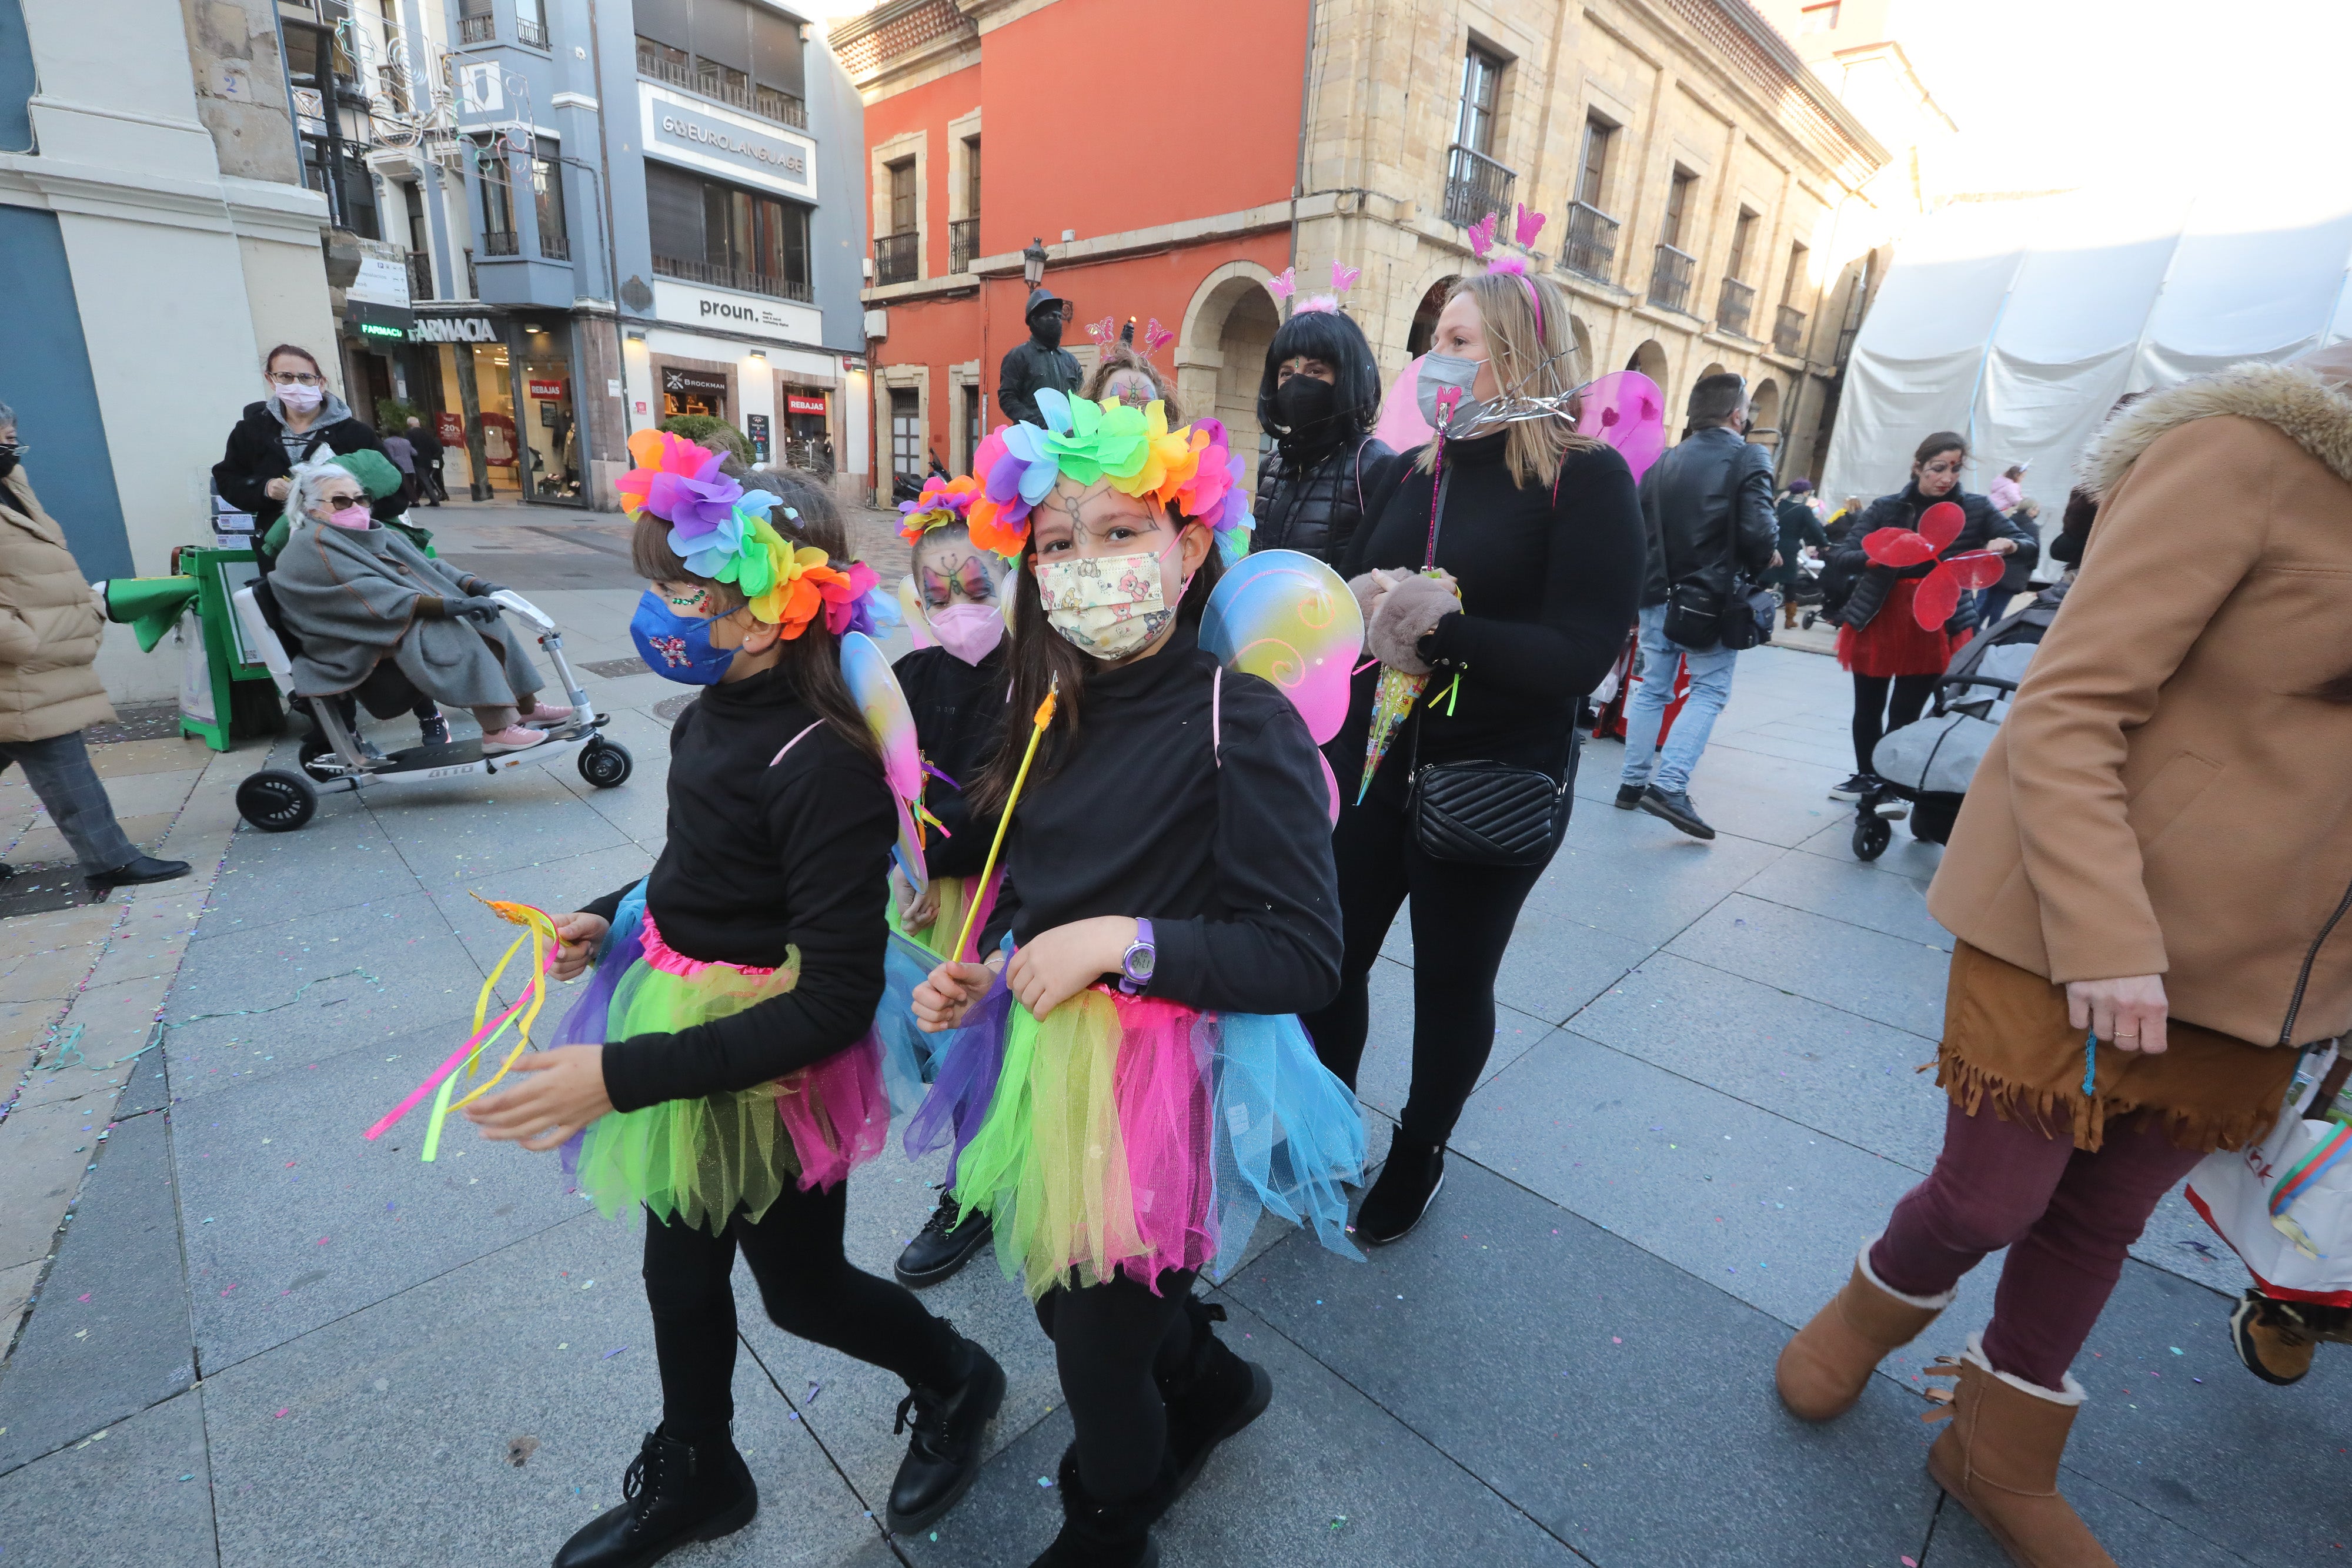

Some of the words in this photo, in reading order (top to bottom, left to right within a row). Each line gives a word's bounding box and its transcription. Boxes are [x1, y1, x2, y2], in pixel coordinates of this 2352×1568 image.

[223, 76, 238, 93] 2
[700, 300, 759, 322] proun.
[531, 386, 560, 394] REBAJAS
[791, 400, 824, 410] REBAJAS
